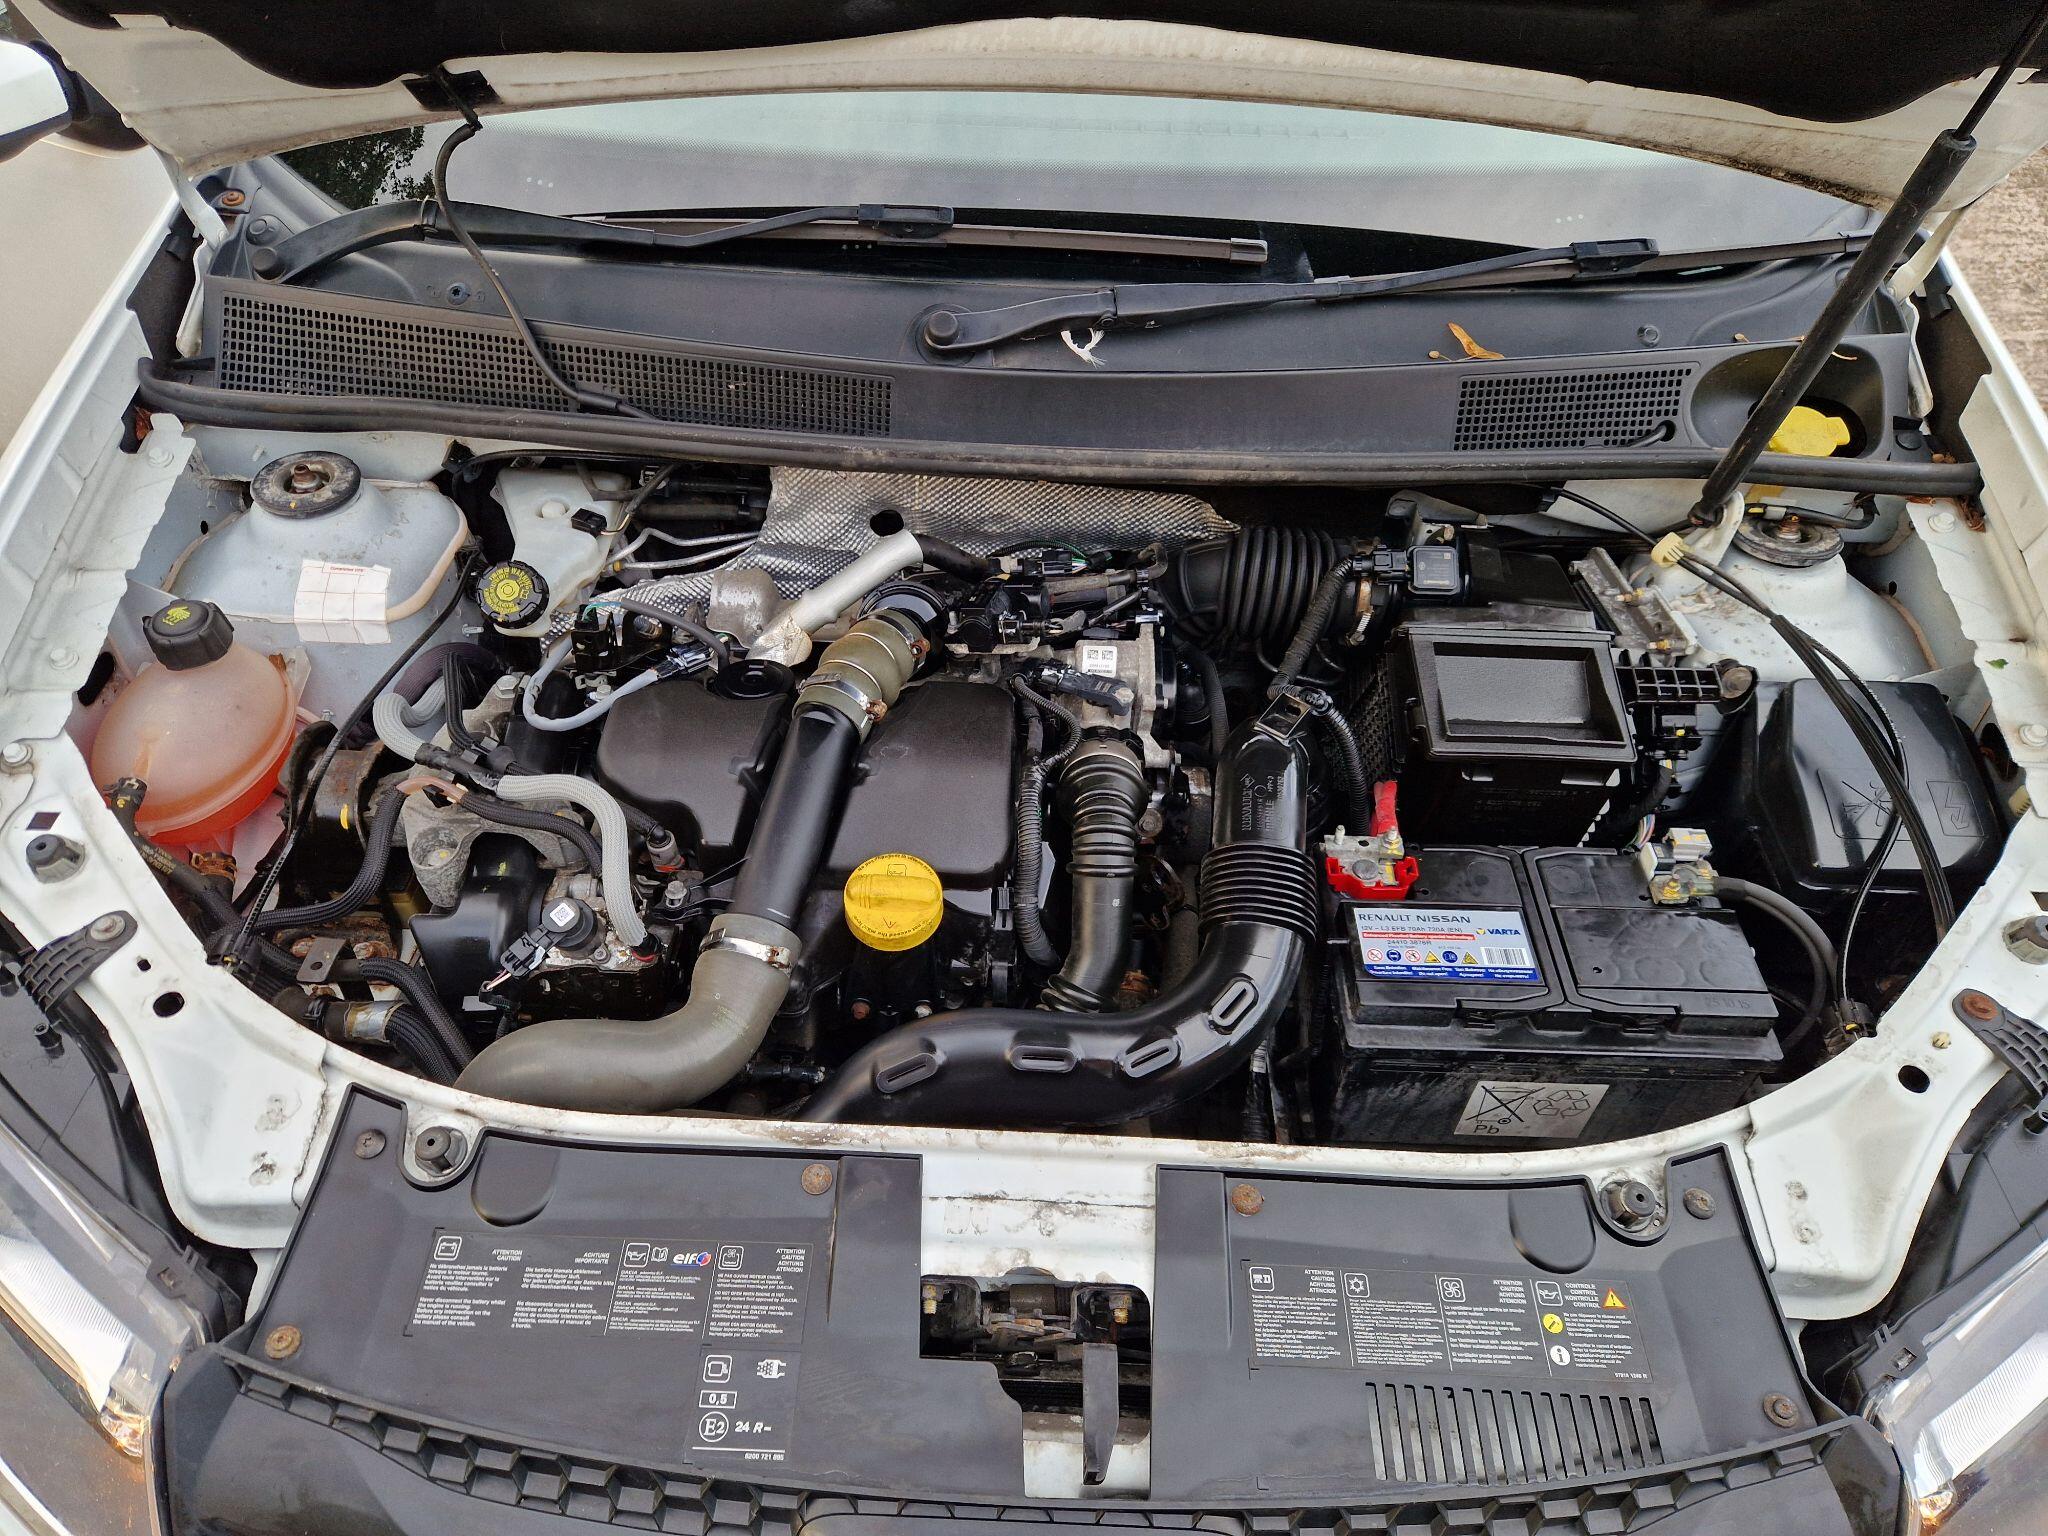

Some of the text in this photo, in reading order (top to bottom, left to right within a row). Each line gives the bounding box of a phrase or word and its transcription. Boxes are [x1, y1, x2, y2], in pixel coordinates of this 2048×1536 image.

[1242, 788, 1252, 831] RENAULT
[1359, 913, 1471, 923] RENAULT NISSAN
[1473, 1124, 1500, 1134] Pb
[673, 1253, 698, 1264] elf
[709, 1394, 727, 1405] 0,5
[704, 1419, 724, 1436] E2
[735, 1421, 750, 1432] 24
